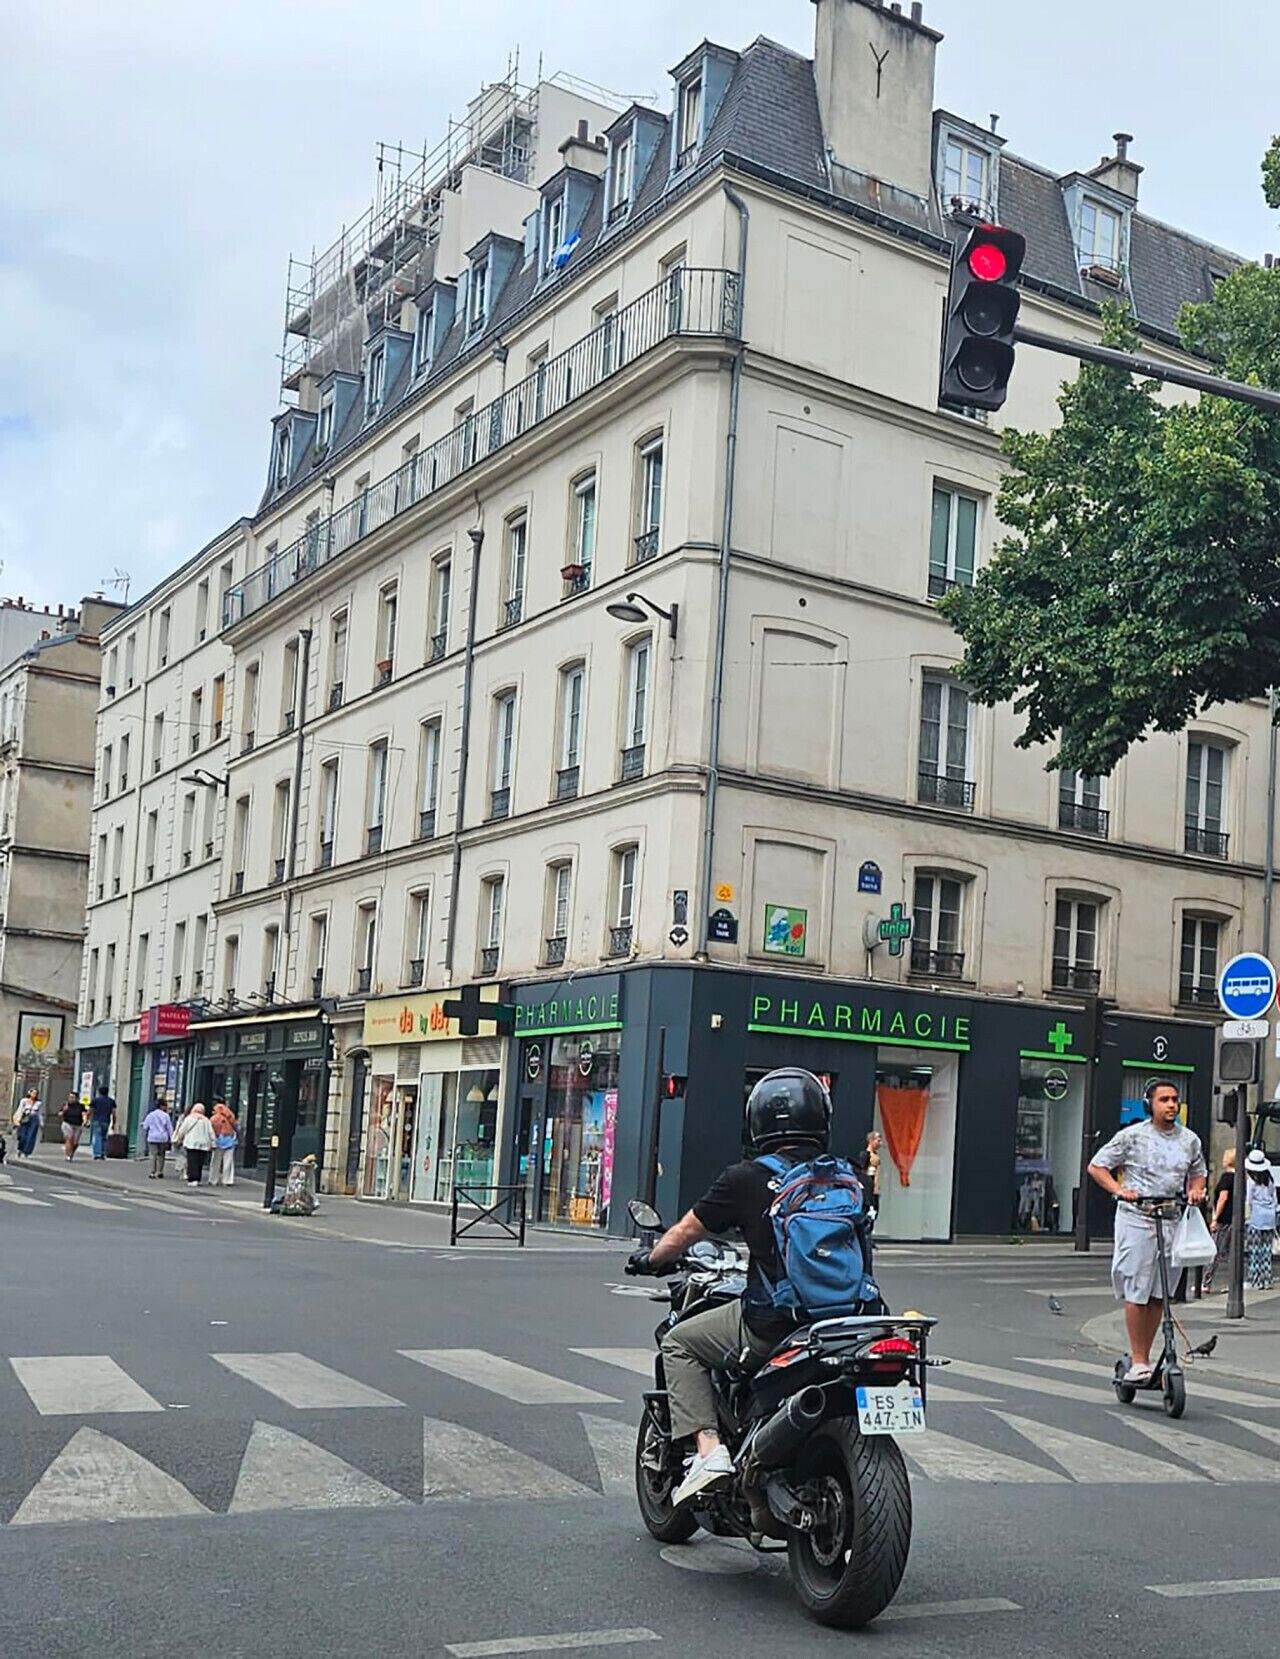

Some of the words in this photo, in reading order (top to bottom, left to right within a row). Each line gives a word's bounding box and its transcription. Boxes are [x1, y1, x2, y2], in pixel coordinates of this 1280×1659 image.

[515, 994, 618, 1027] PHARMACIE
[753, 996, 970, 1040] PHARMACIE
[875, 1395, 895, 1410] ES
